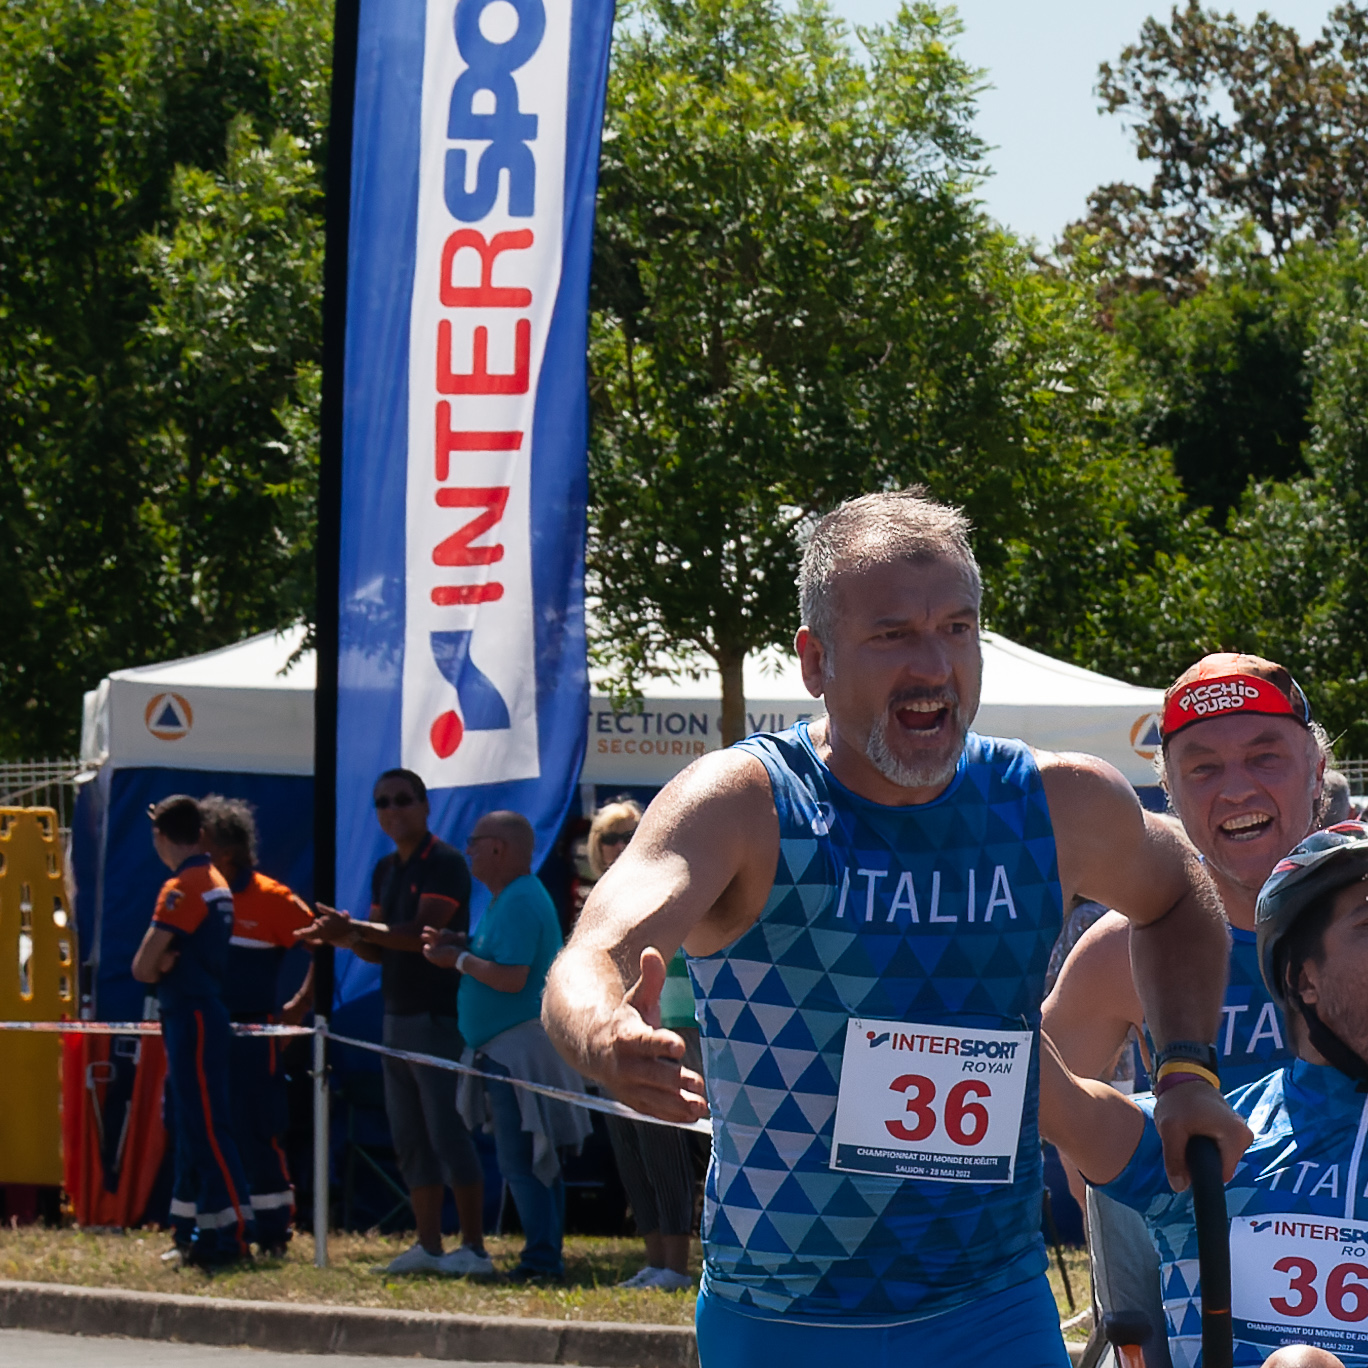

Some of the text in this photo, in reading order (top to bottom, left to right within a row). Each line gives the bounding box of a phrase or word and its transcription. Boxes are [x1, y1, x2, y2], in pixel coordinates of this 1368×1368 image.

[1193, 696, 1245, 715] DURO
[588, 711, 708, 735] ECTION
[597, 738, 705, 756] SECOURIR
[836, 865, 1017, 923] ITALIA
[892, 1033, 1018, 1059] INTERSPORT
[962, 1060, 1013, 1075] ROYAN
[884, 1074, 992, 1146] 36
[856, 1148, 919, 1161] CHAMPIONNAT
[919, 1154, 932, 1162] DU
[933, 1155, 963, 1165] MONDE
[963, 1157, 973, 1165] DE
[1246, 1322, 1301, 1335] CHAMPIONNAT
[1302, 1328, 1314, 1336] DU
[1315, 1329, 1345, 1339] MONDE
[1346, 1333, 1357, 1341] DE
